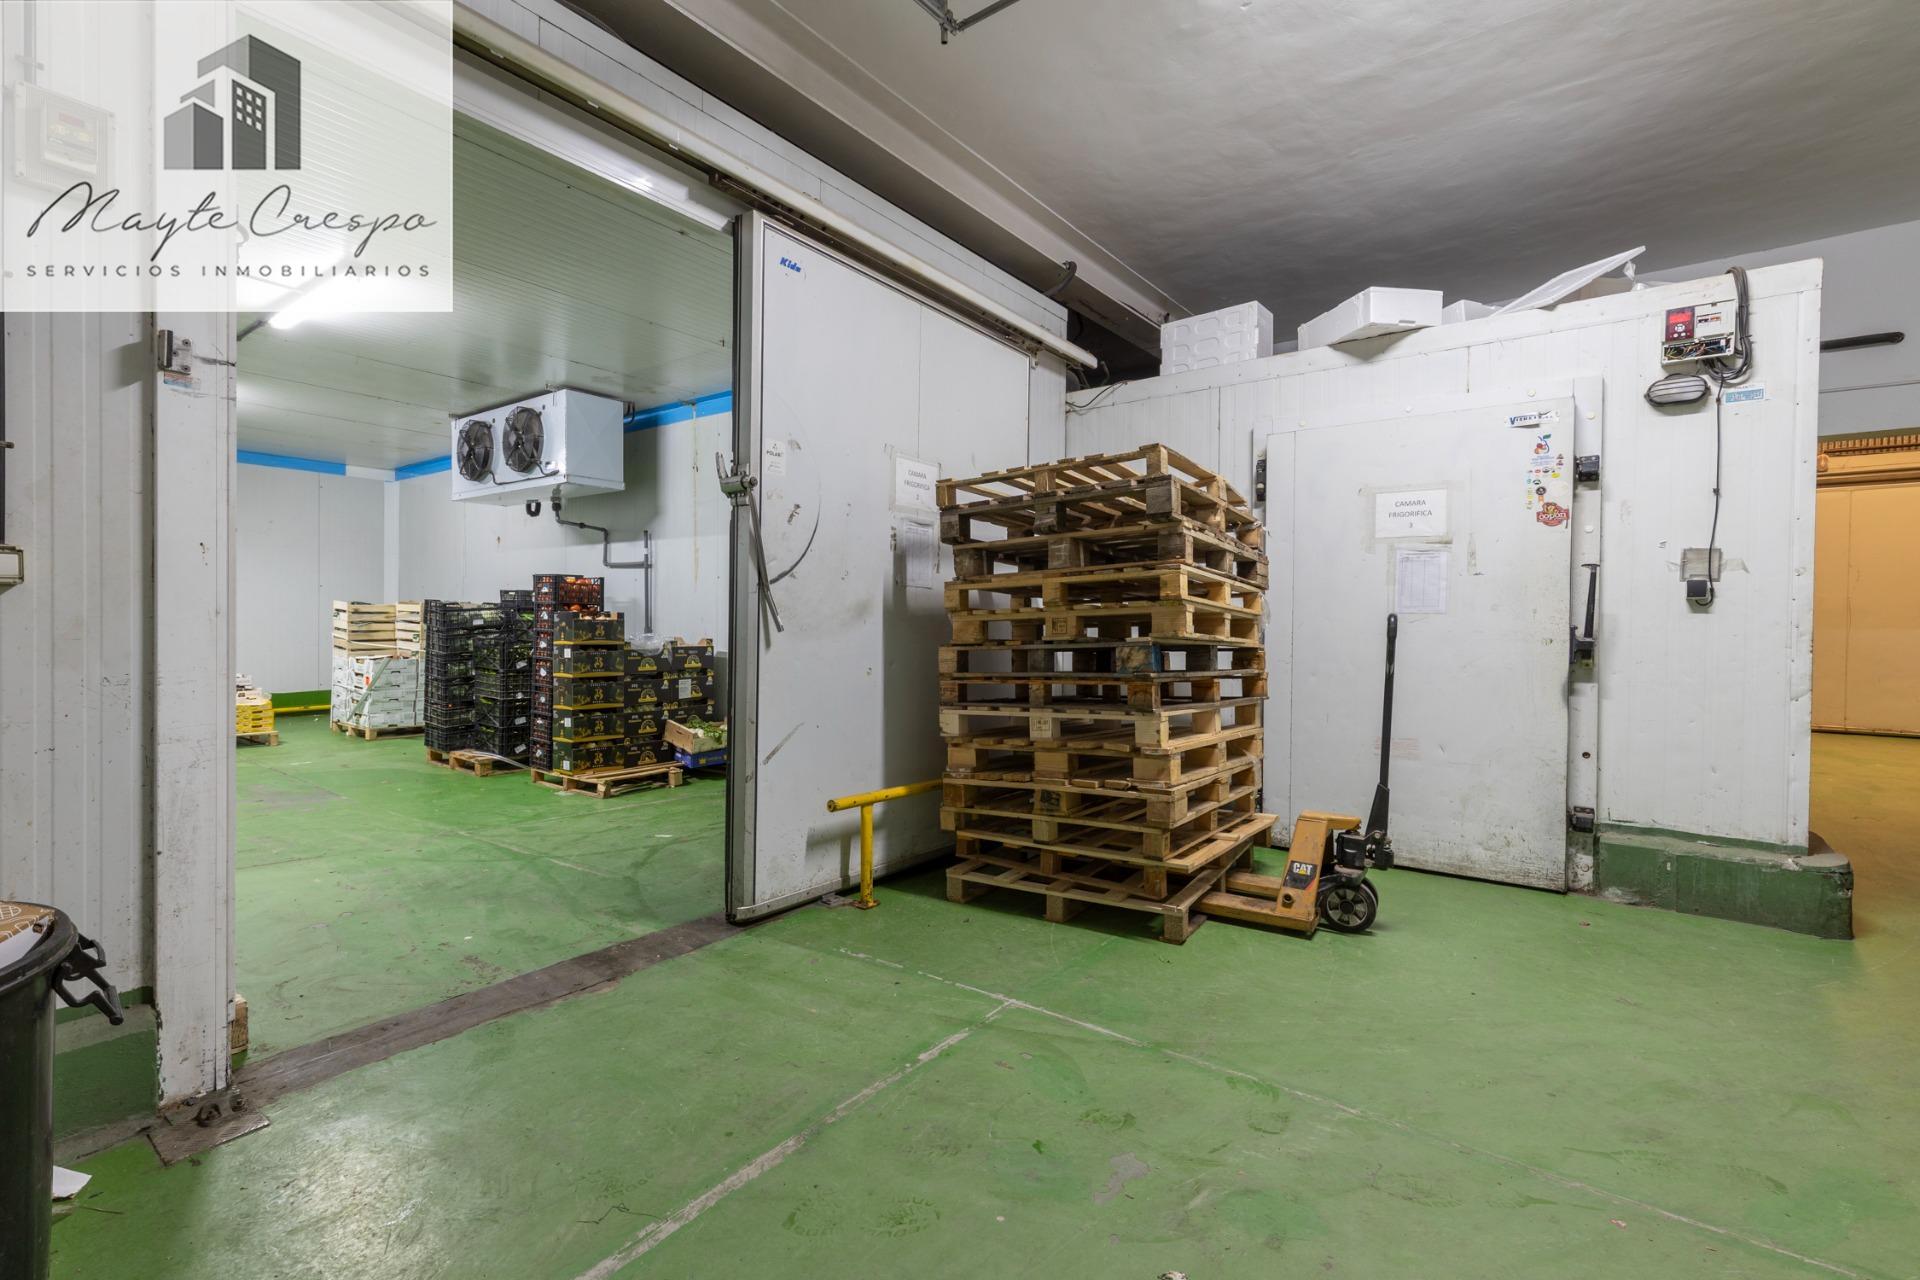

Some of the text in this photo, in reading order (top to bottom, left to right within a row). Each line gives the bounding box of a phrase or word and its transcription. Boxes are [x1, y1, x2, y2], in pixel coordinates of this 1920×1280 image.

[1394, 499, 1427, 508] CAMARA
[1388, 509, 1433, 519] FRIGORIFICA
[1293, 862, 1313, 876] CAT
